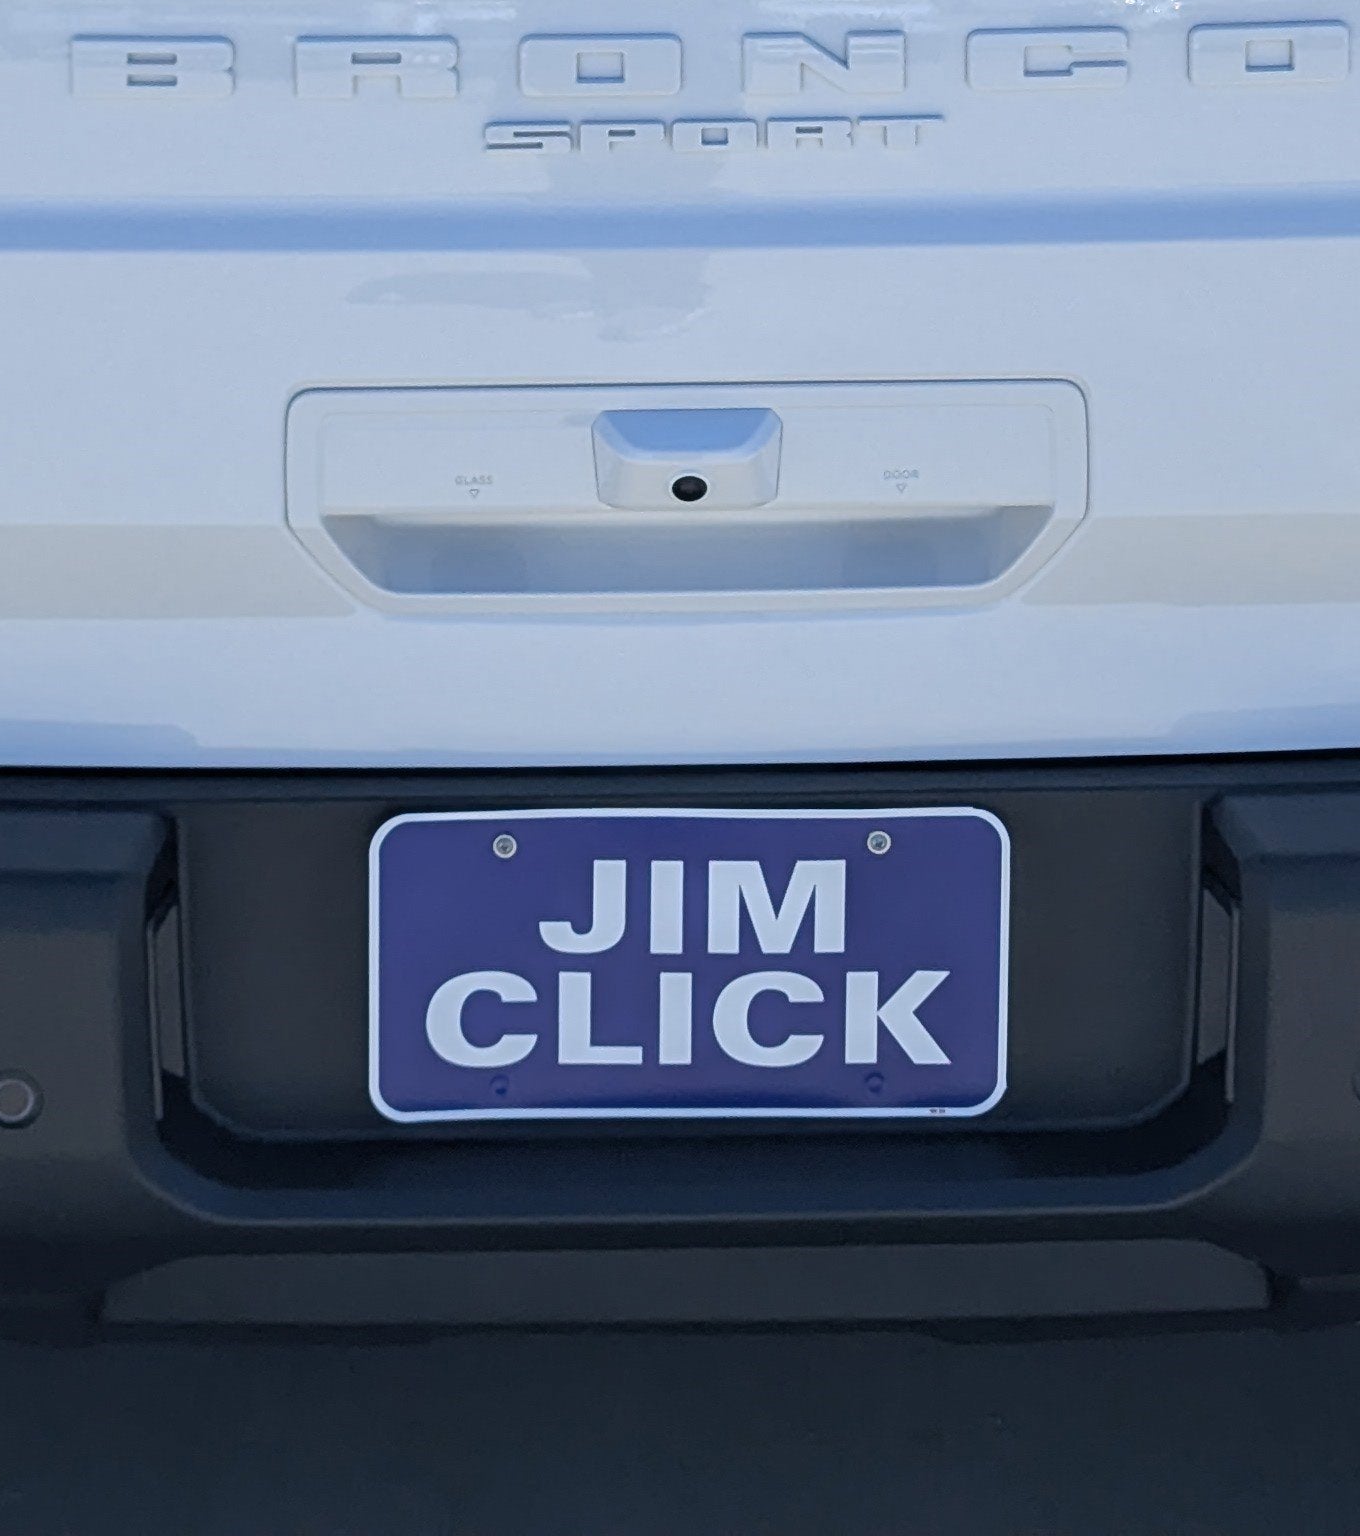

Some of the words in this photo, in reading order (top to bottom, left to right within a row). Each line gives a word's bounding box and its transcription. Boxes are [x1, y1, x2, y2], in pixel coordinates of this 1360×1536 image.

[69, 18, 1351, 100] BRONCO
[482, 114, 944, 154] SPORT
[454, 474, 494, 485] GLASS
[537, 858, 847, 955] JIM
[424, 969, 952, 1068] CLICK
